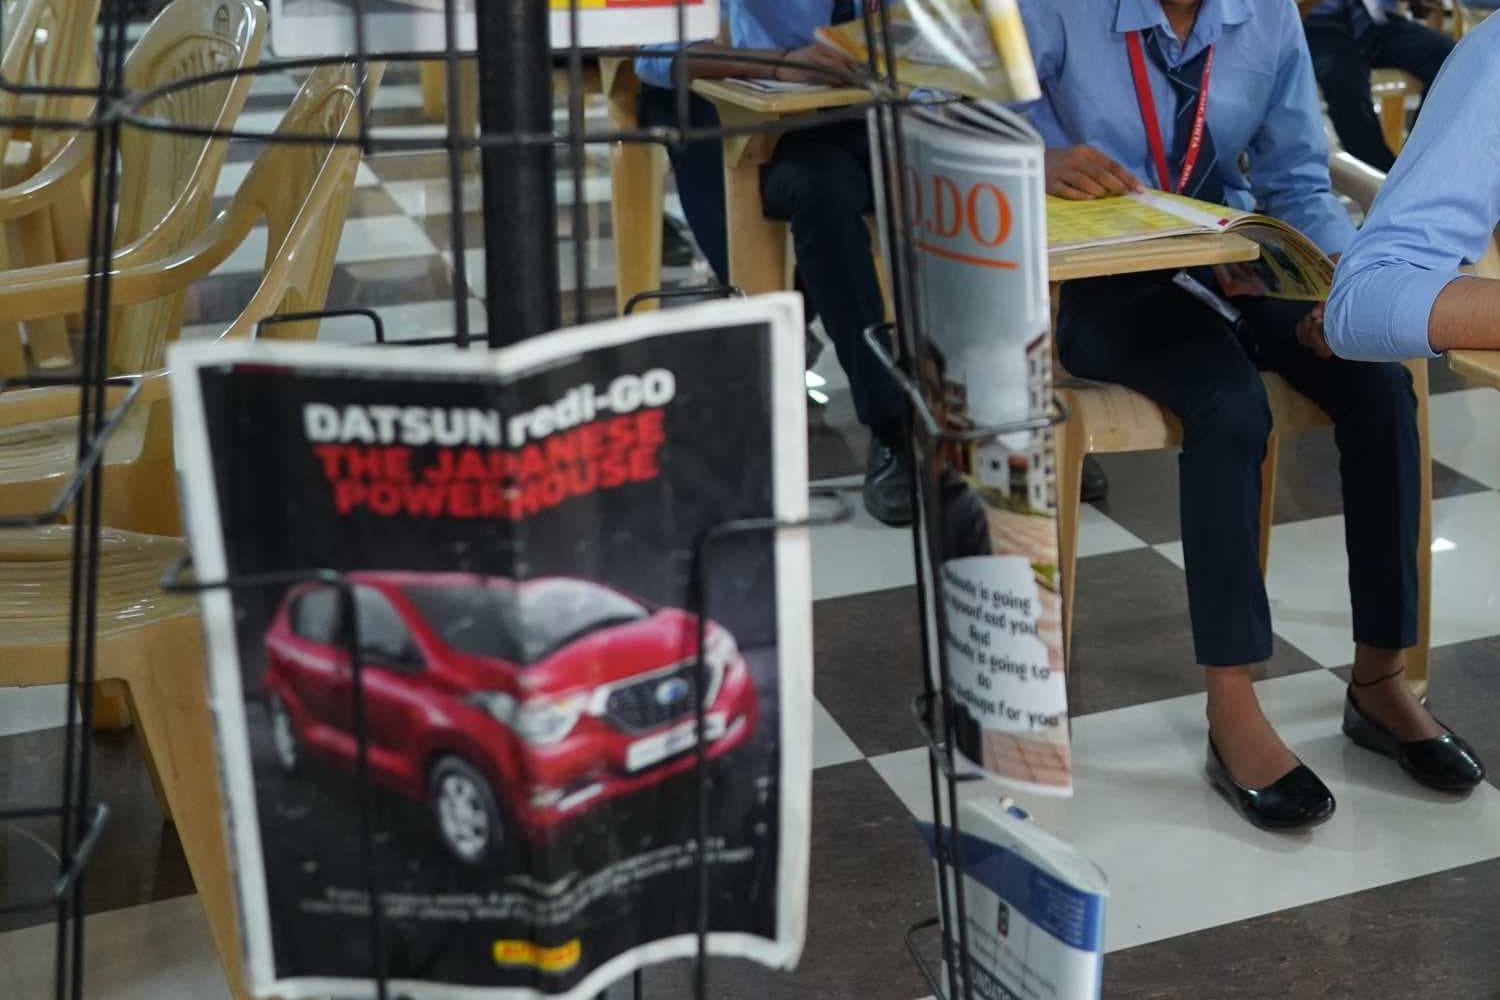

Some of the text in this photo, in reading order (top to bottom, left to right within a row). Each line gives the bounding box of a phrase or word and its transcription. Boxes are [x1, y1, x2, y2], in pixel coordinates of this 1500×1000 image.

[303, 367, 676, 447] DATSUN redi-GO
[313, 408, 666, 482] THE JAPANESE
[335, 448, 658, 521] POWERHOUSE
[992, 588, 1032, 616] going
[989, 654, 1028, 682] going
